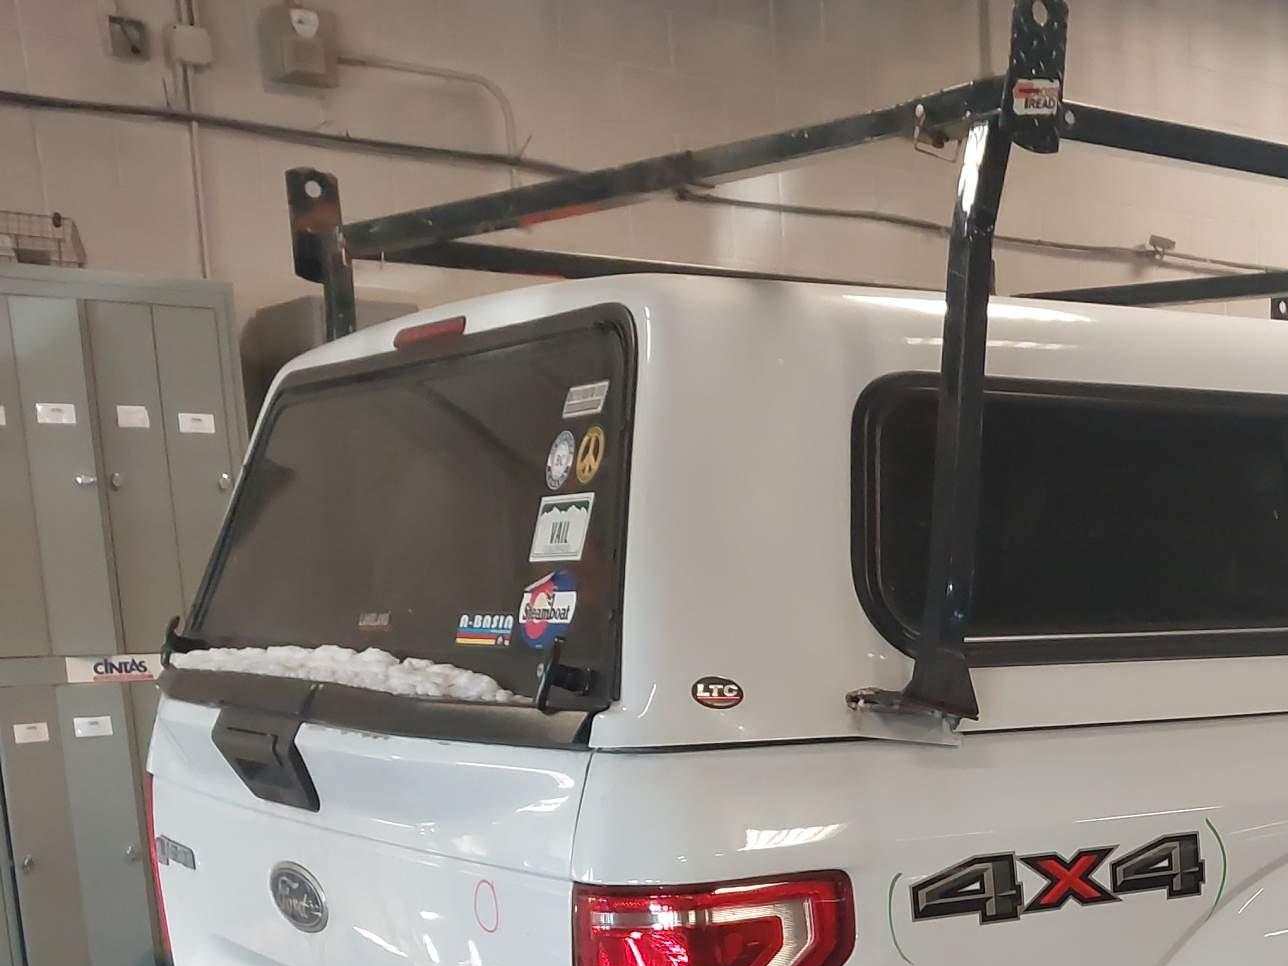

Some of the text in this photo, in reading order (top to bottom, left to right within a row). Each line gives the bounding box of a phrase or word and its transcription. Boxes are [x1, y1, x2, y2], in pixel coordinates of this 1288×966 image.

[550, 520, 570, 544] VAIL
[93, 658, 148, 675] CINTAS
[696, 683, 739, 697] LTC
